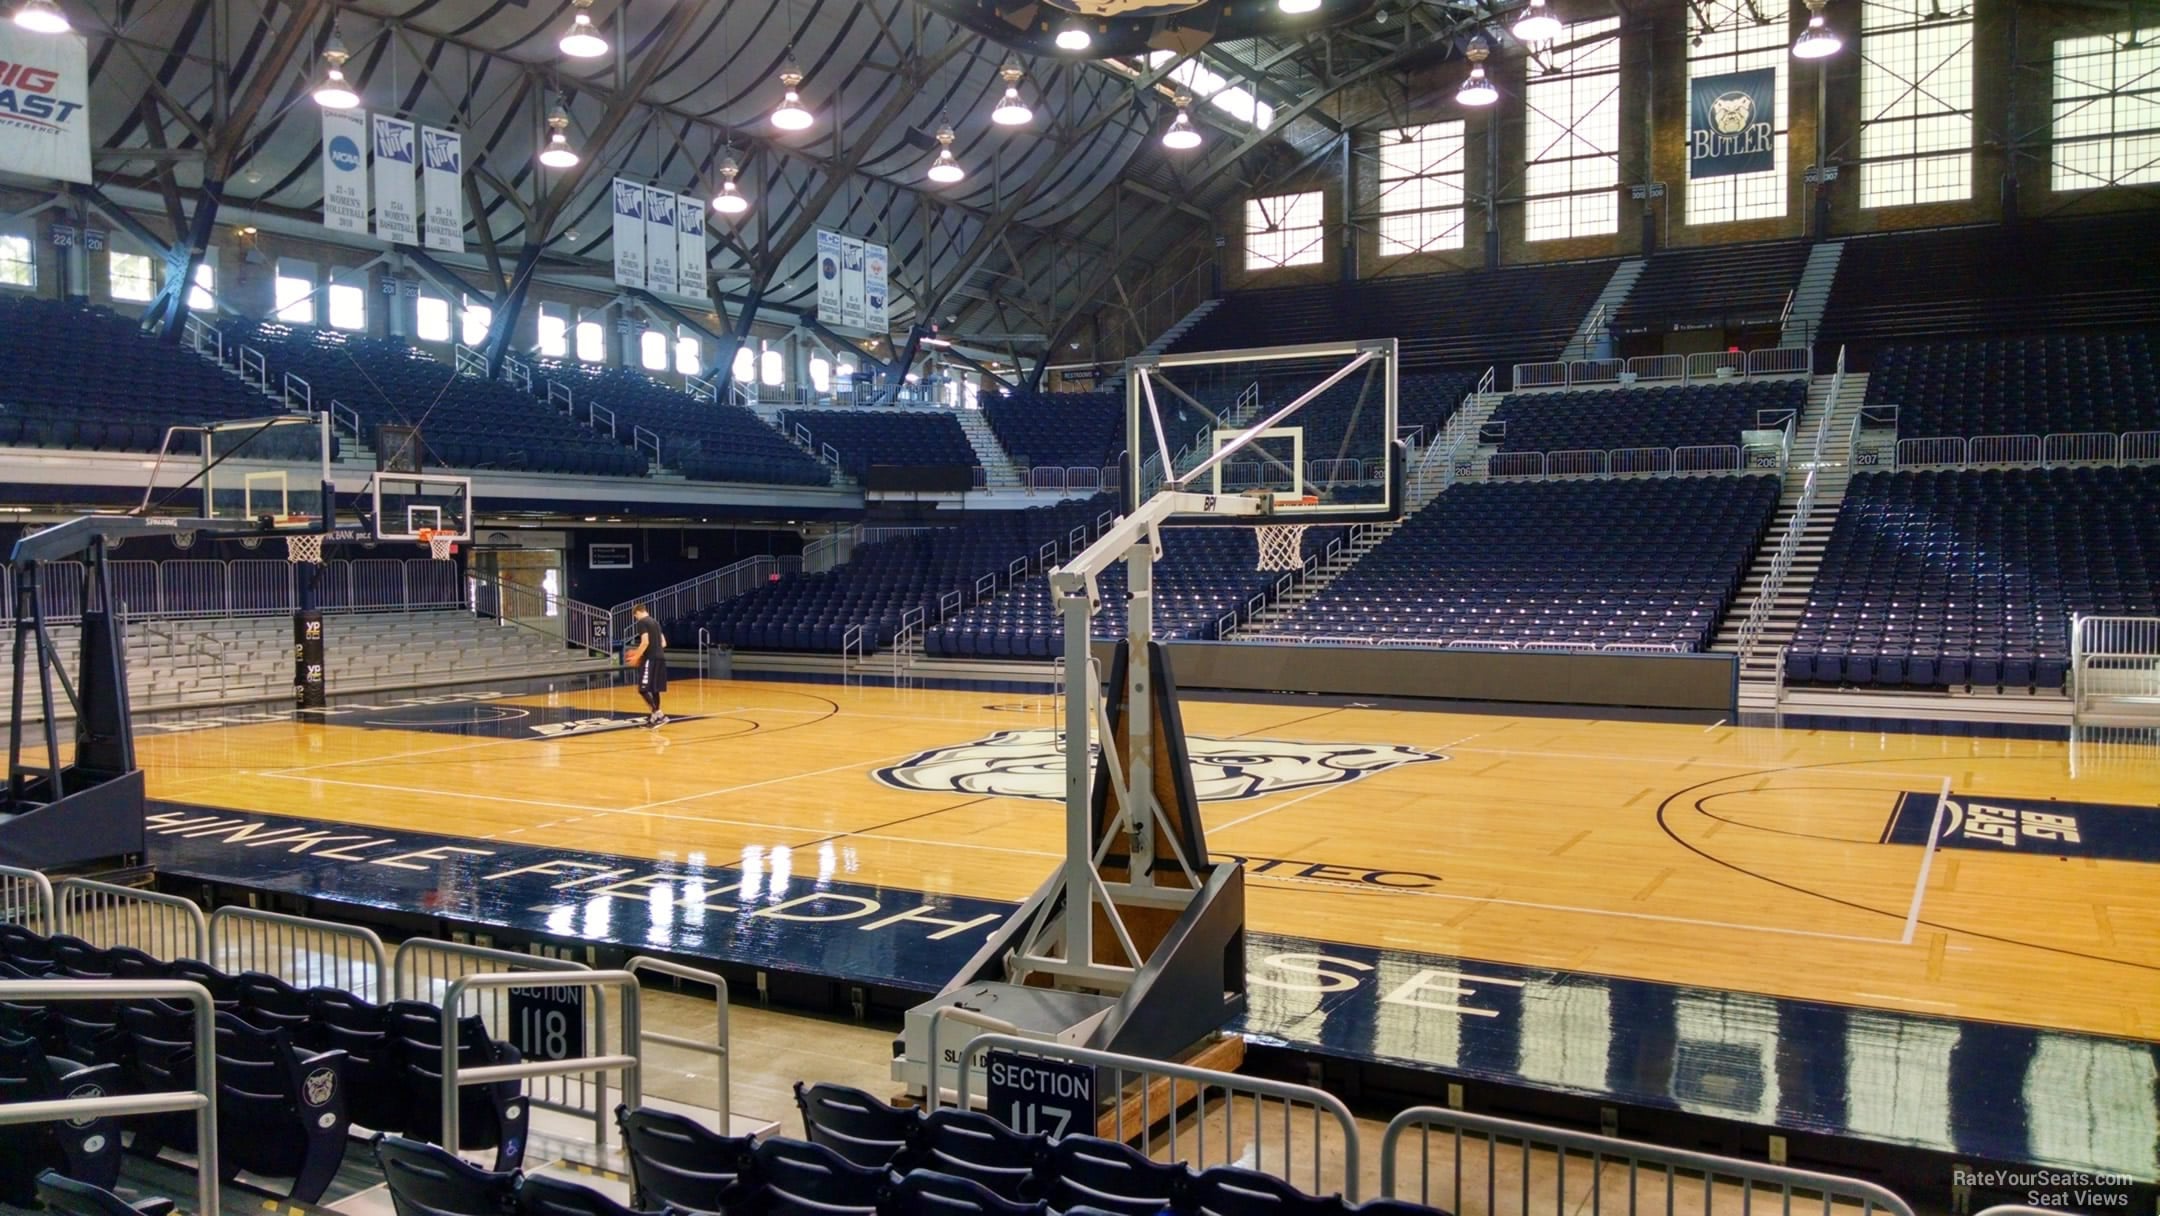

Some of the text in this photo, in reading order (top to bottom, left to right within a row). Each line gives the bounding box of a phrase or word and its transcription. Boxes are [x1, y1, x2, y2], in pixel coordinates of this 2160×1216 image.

[0, 88, 83, 122] AST
[1693, 122, 1773, 160] BUTLER
[331, 151, 360, 164] NCAA
[53, 233, 72, 247] 224
[1757, 457, 1776, 468] 206
[1858, 454, 1878, 465] 207
[1373, 470, 1386, 479] 20
[1455, 467, 1471, 477] 206
[1203, 496, 1217, 512] BPI
[145, 811, 497, 870] HINKLE
[521, 1005, 567, 1060] 118
[991, 1062, 1090, 1101] SECTION
